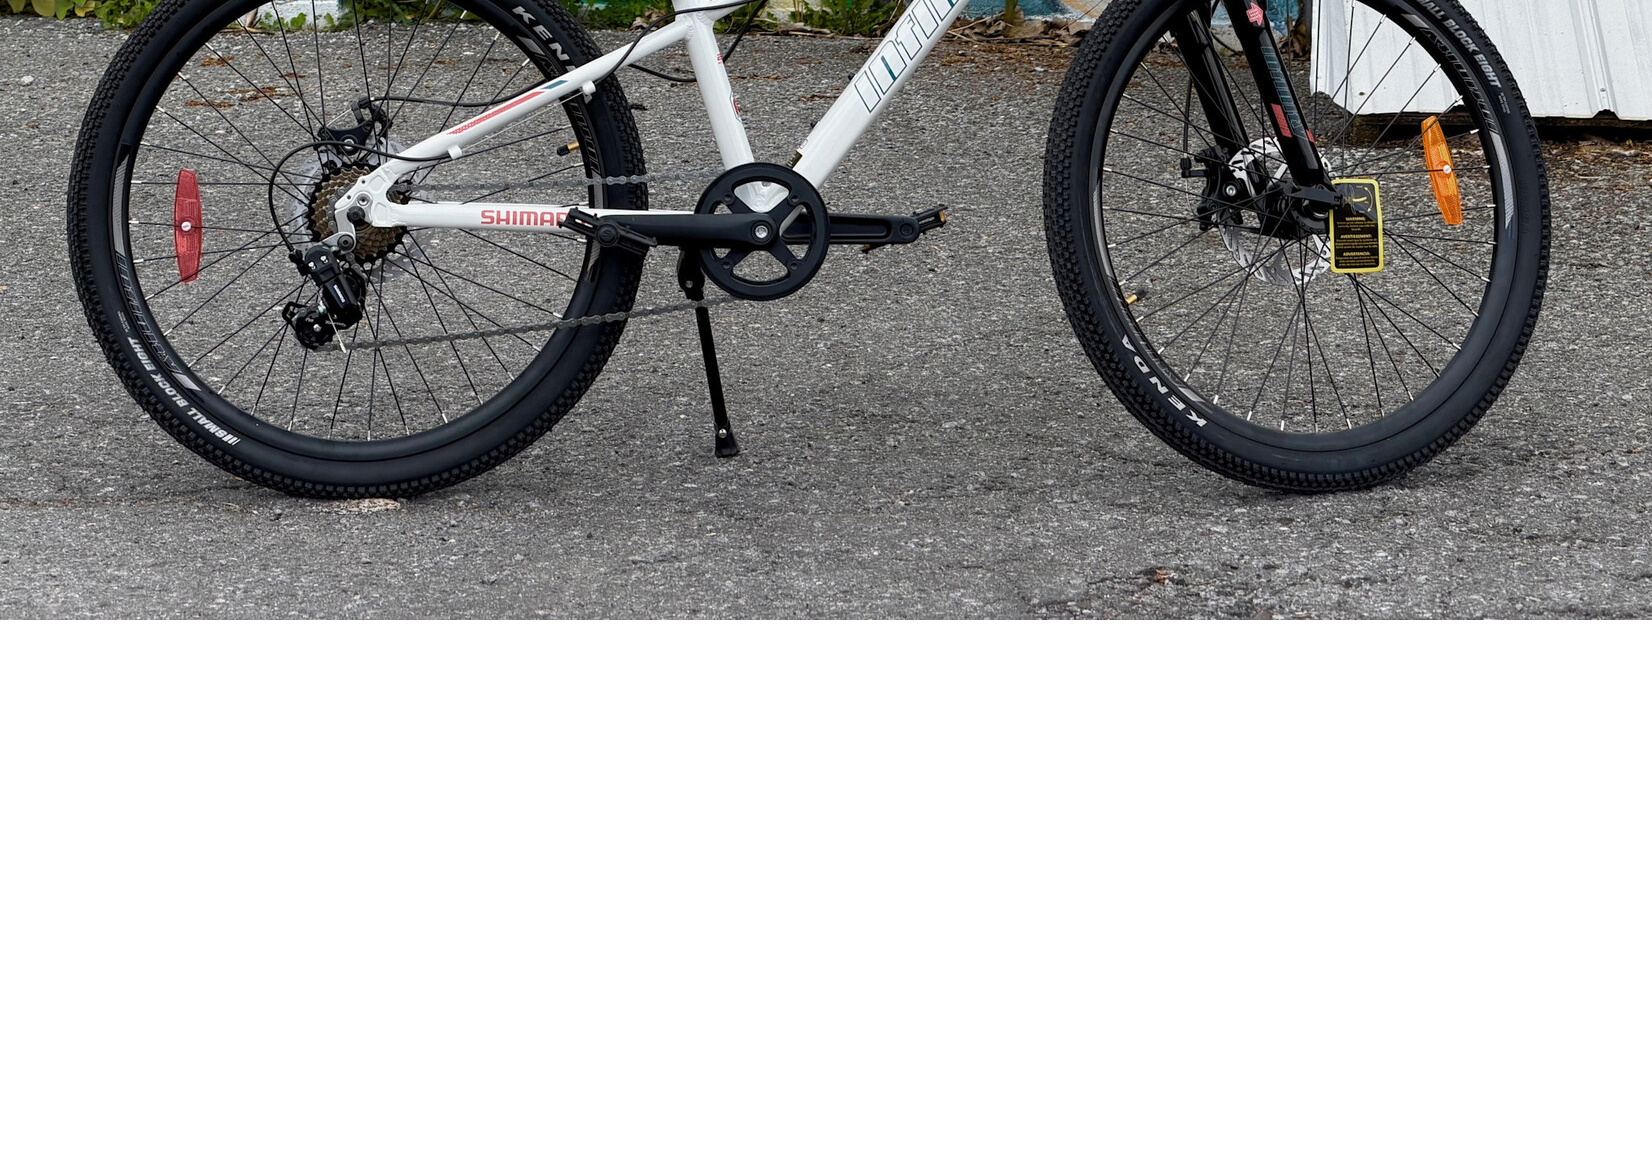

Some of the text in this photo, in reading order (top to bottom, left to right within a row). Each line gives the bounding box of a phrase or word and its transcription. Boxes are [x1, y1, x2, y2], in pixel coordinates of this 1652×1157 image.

[1443, 19, 1480, 53] BLOCK
[1473, 54, 1502, 88] EIGHT
[127, 337, 227, 439] SMALL BLOCK EIGHT
[1122, 334, 1207, 427] KENDA
